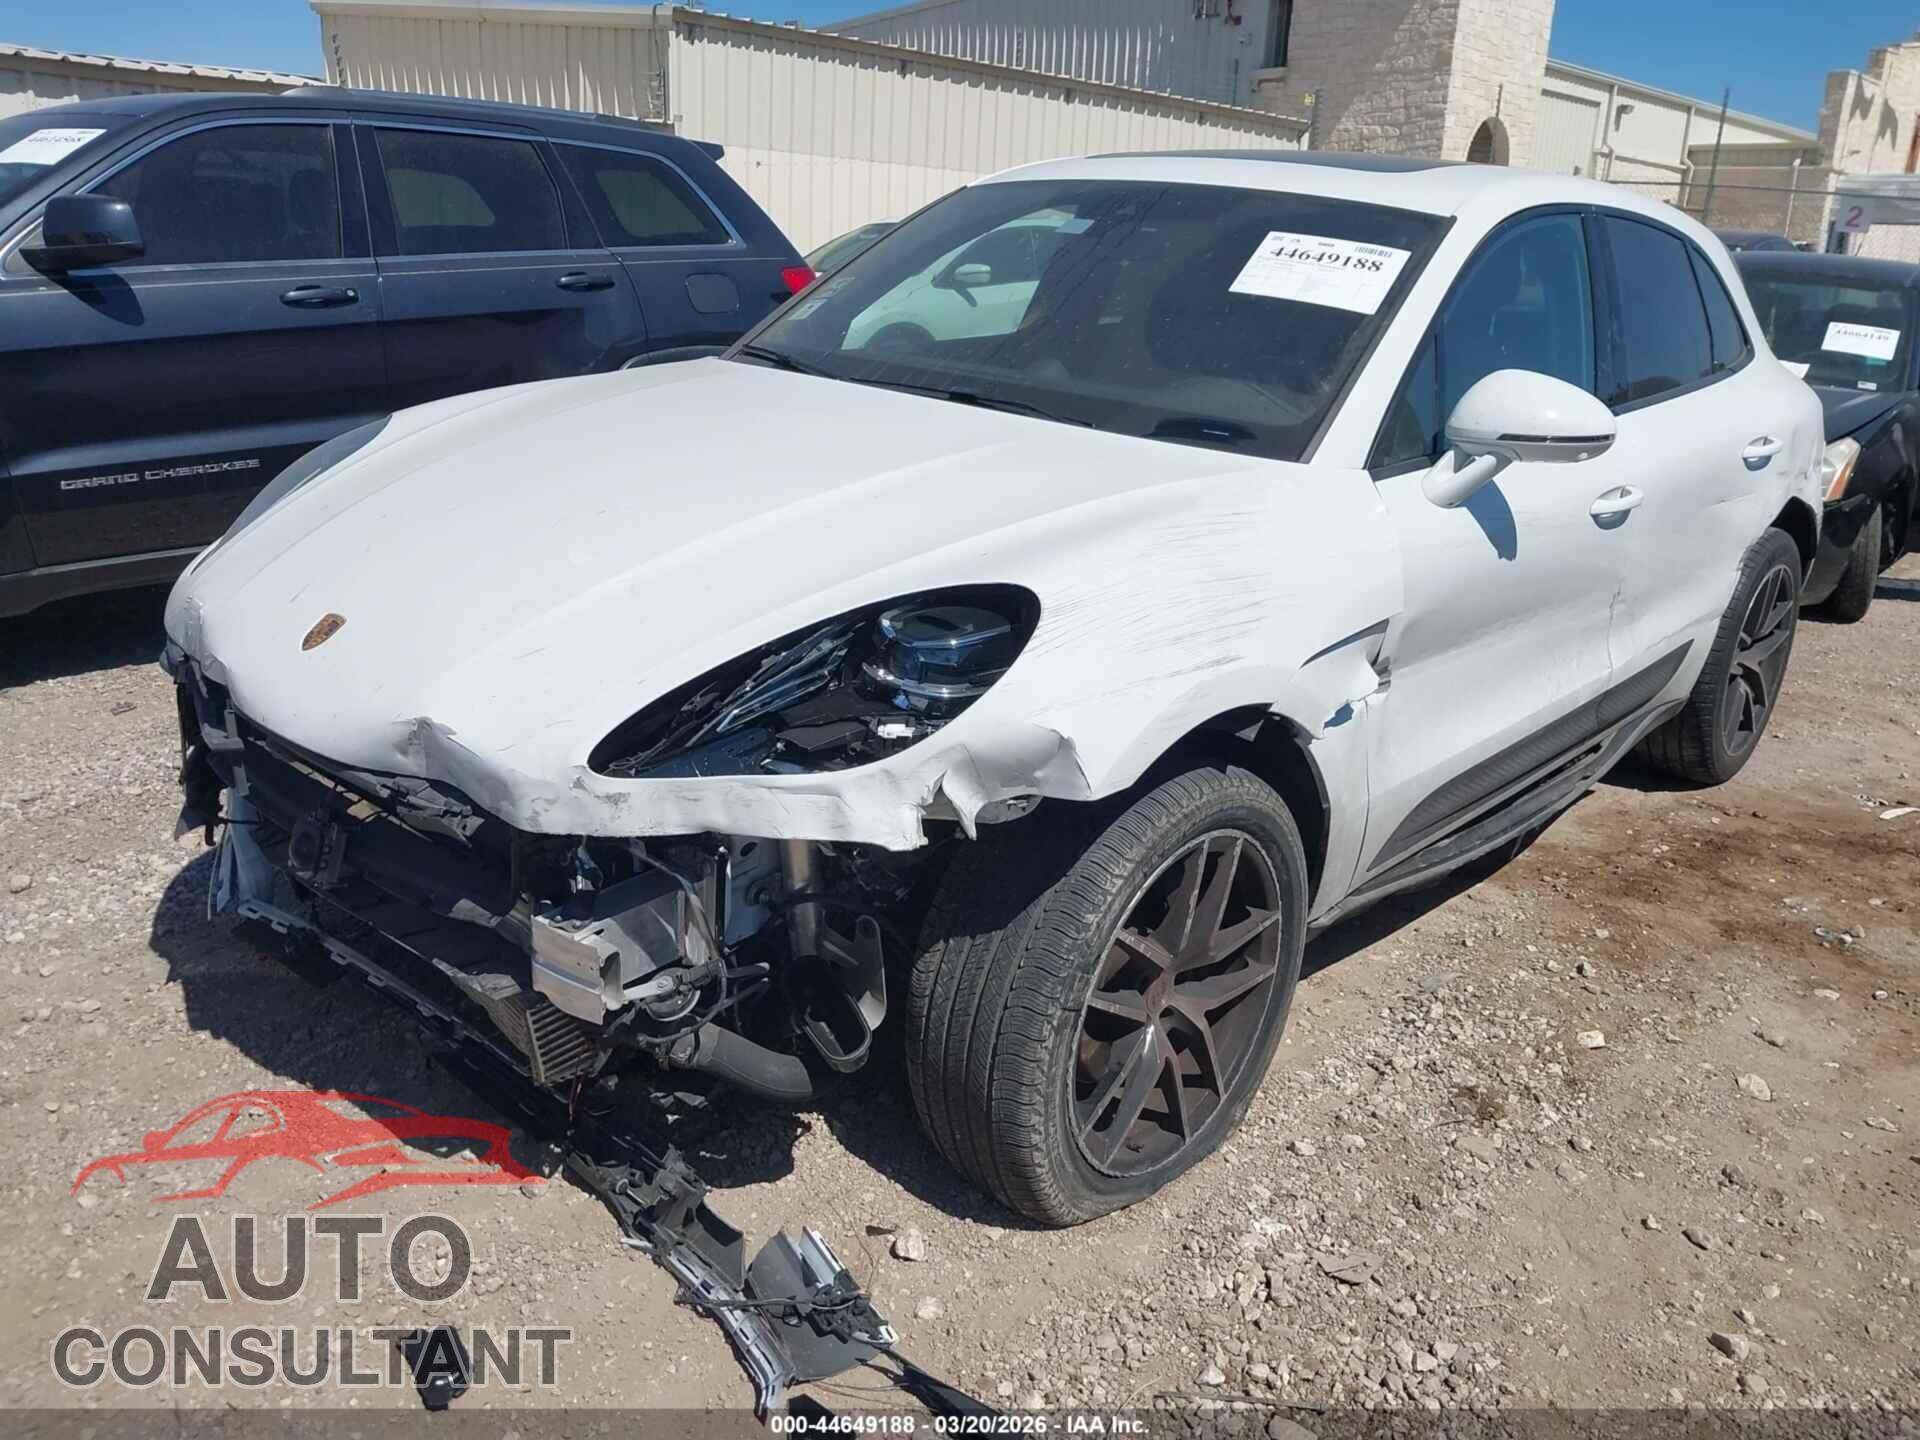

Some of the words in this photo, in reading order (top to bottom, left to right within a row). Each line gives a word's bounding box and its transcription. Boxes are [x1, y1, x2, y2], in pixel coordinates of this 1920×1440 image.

[1845, 206, 1864, 228] 2
[1271, 246, 1384, 272] 44649188
[60, 472, 139, 490] GRAND
[144, 458, 260, 480] CHEROKEE
